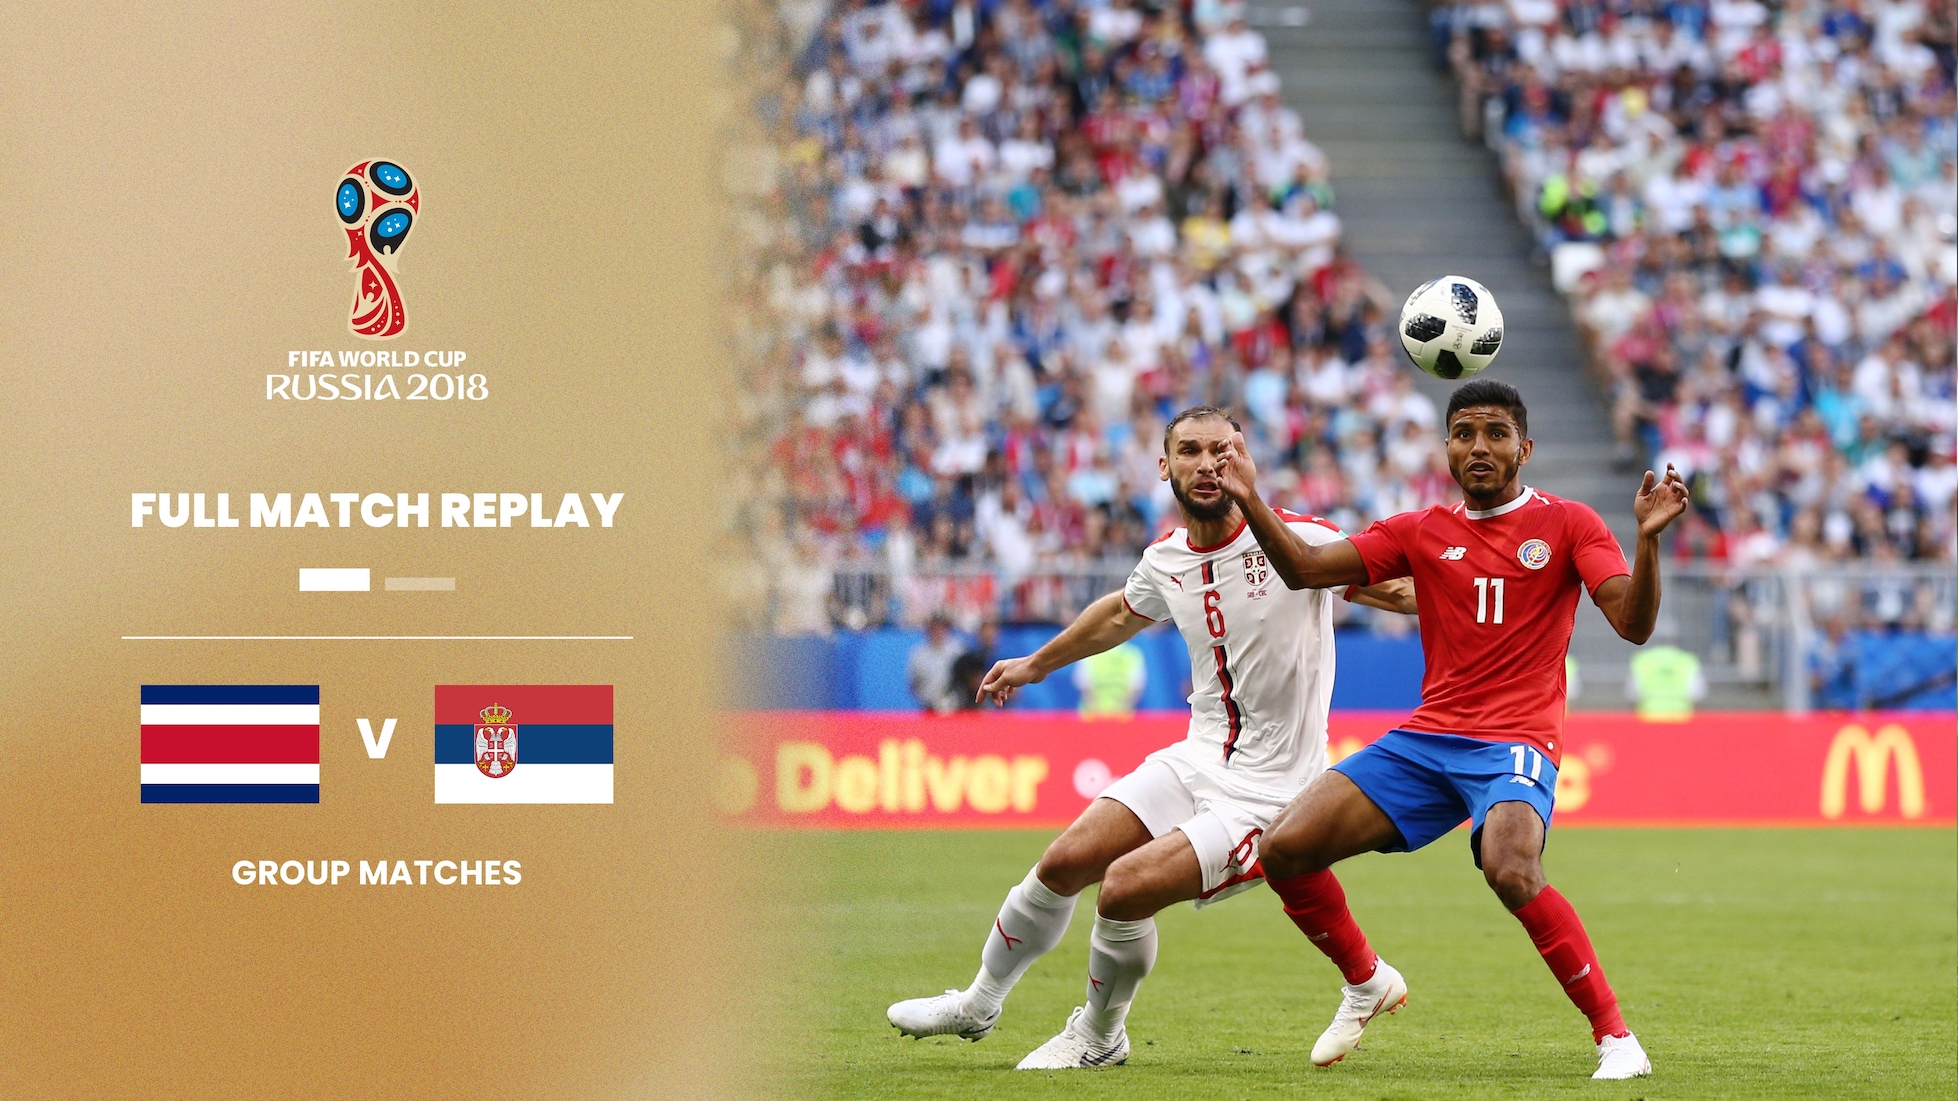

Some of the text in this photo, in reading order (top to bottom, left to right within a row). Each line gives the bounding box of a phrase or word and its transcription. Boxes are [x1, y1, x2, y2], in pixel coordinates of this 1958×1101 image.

[1203, 589, 1226, 639] 6
[1473, 577, 1504, 625] 11
[775, 738, 1049, 814] Deliver
[1509, 745, 1543, 781] 11
